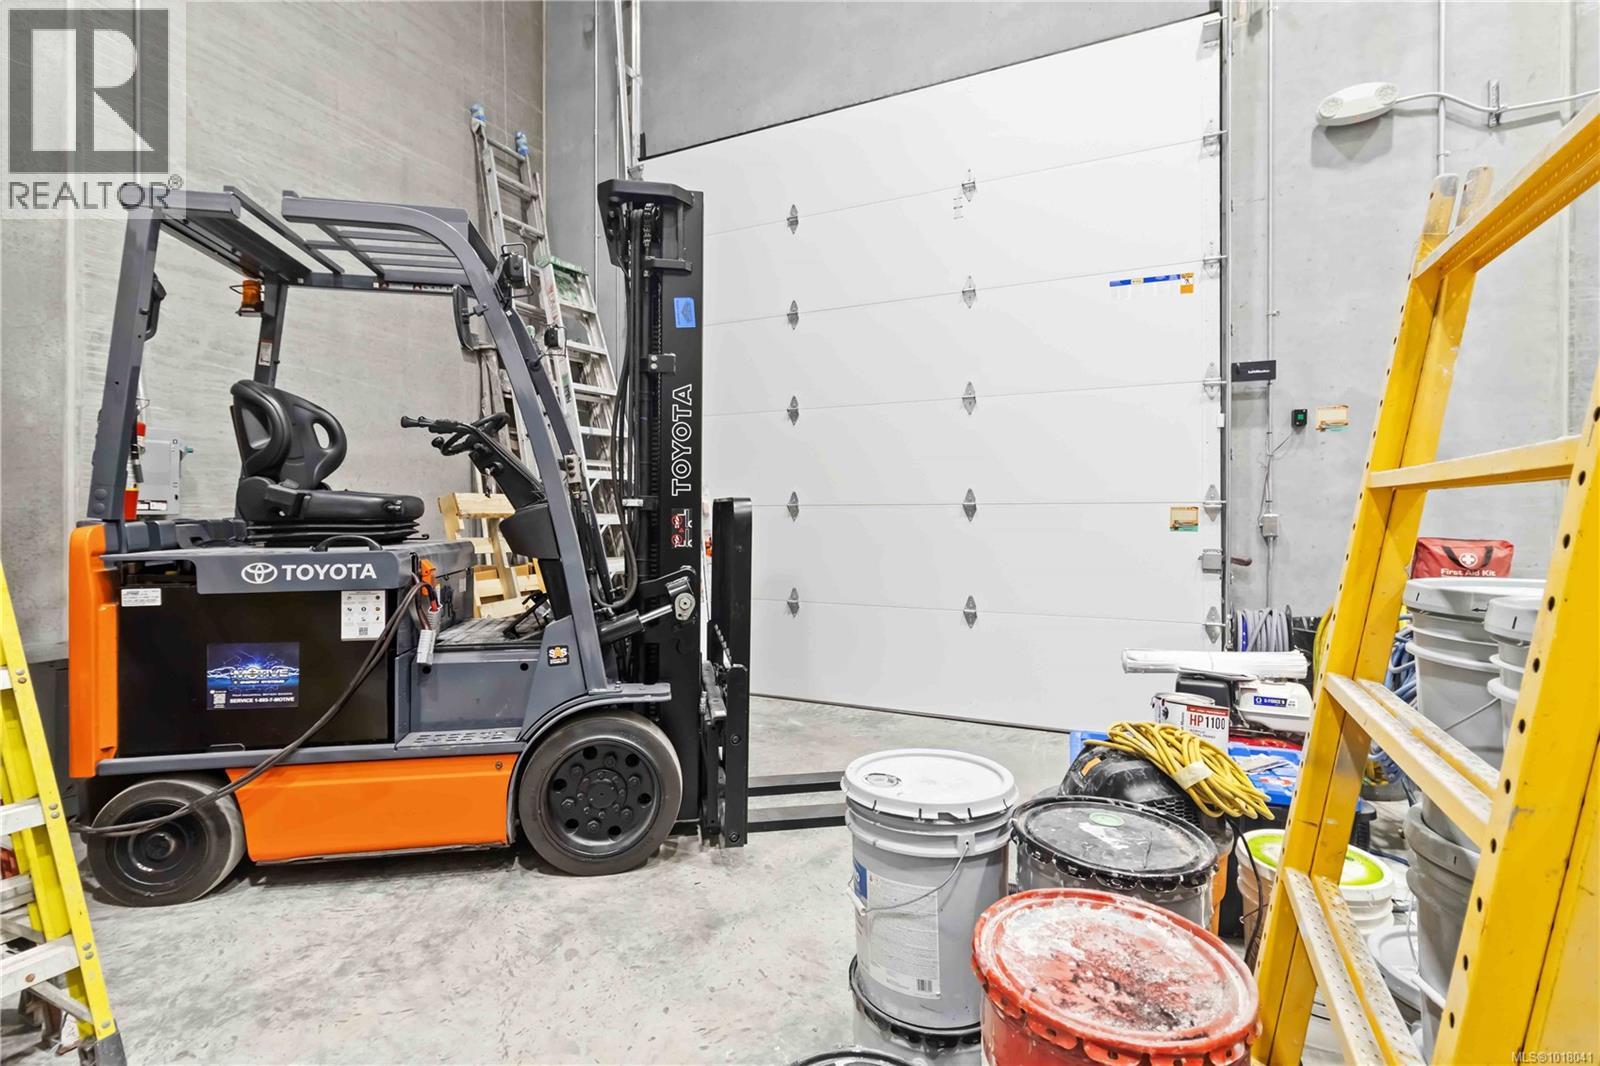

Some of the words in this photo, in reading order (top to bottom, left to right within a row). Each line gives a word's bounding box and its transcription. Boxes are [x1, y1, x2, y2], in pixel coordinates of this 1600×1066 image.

[671, 383, 692, 497] TOYOTA
[281, 563, 377, 581] TOYOTA
[1440, 568, 1462, 576] First
[1482, 569, 1496, 577] Kit
[1189, 714, 1204, 727] HP
[1205, 715, 1226, 730] 1100
